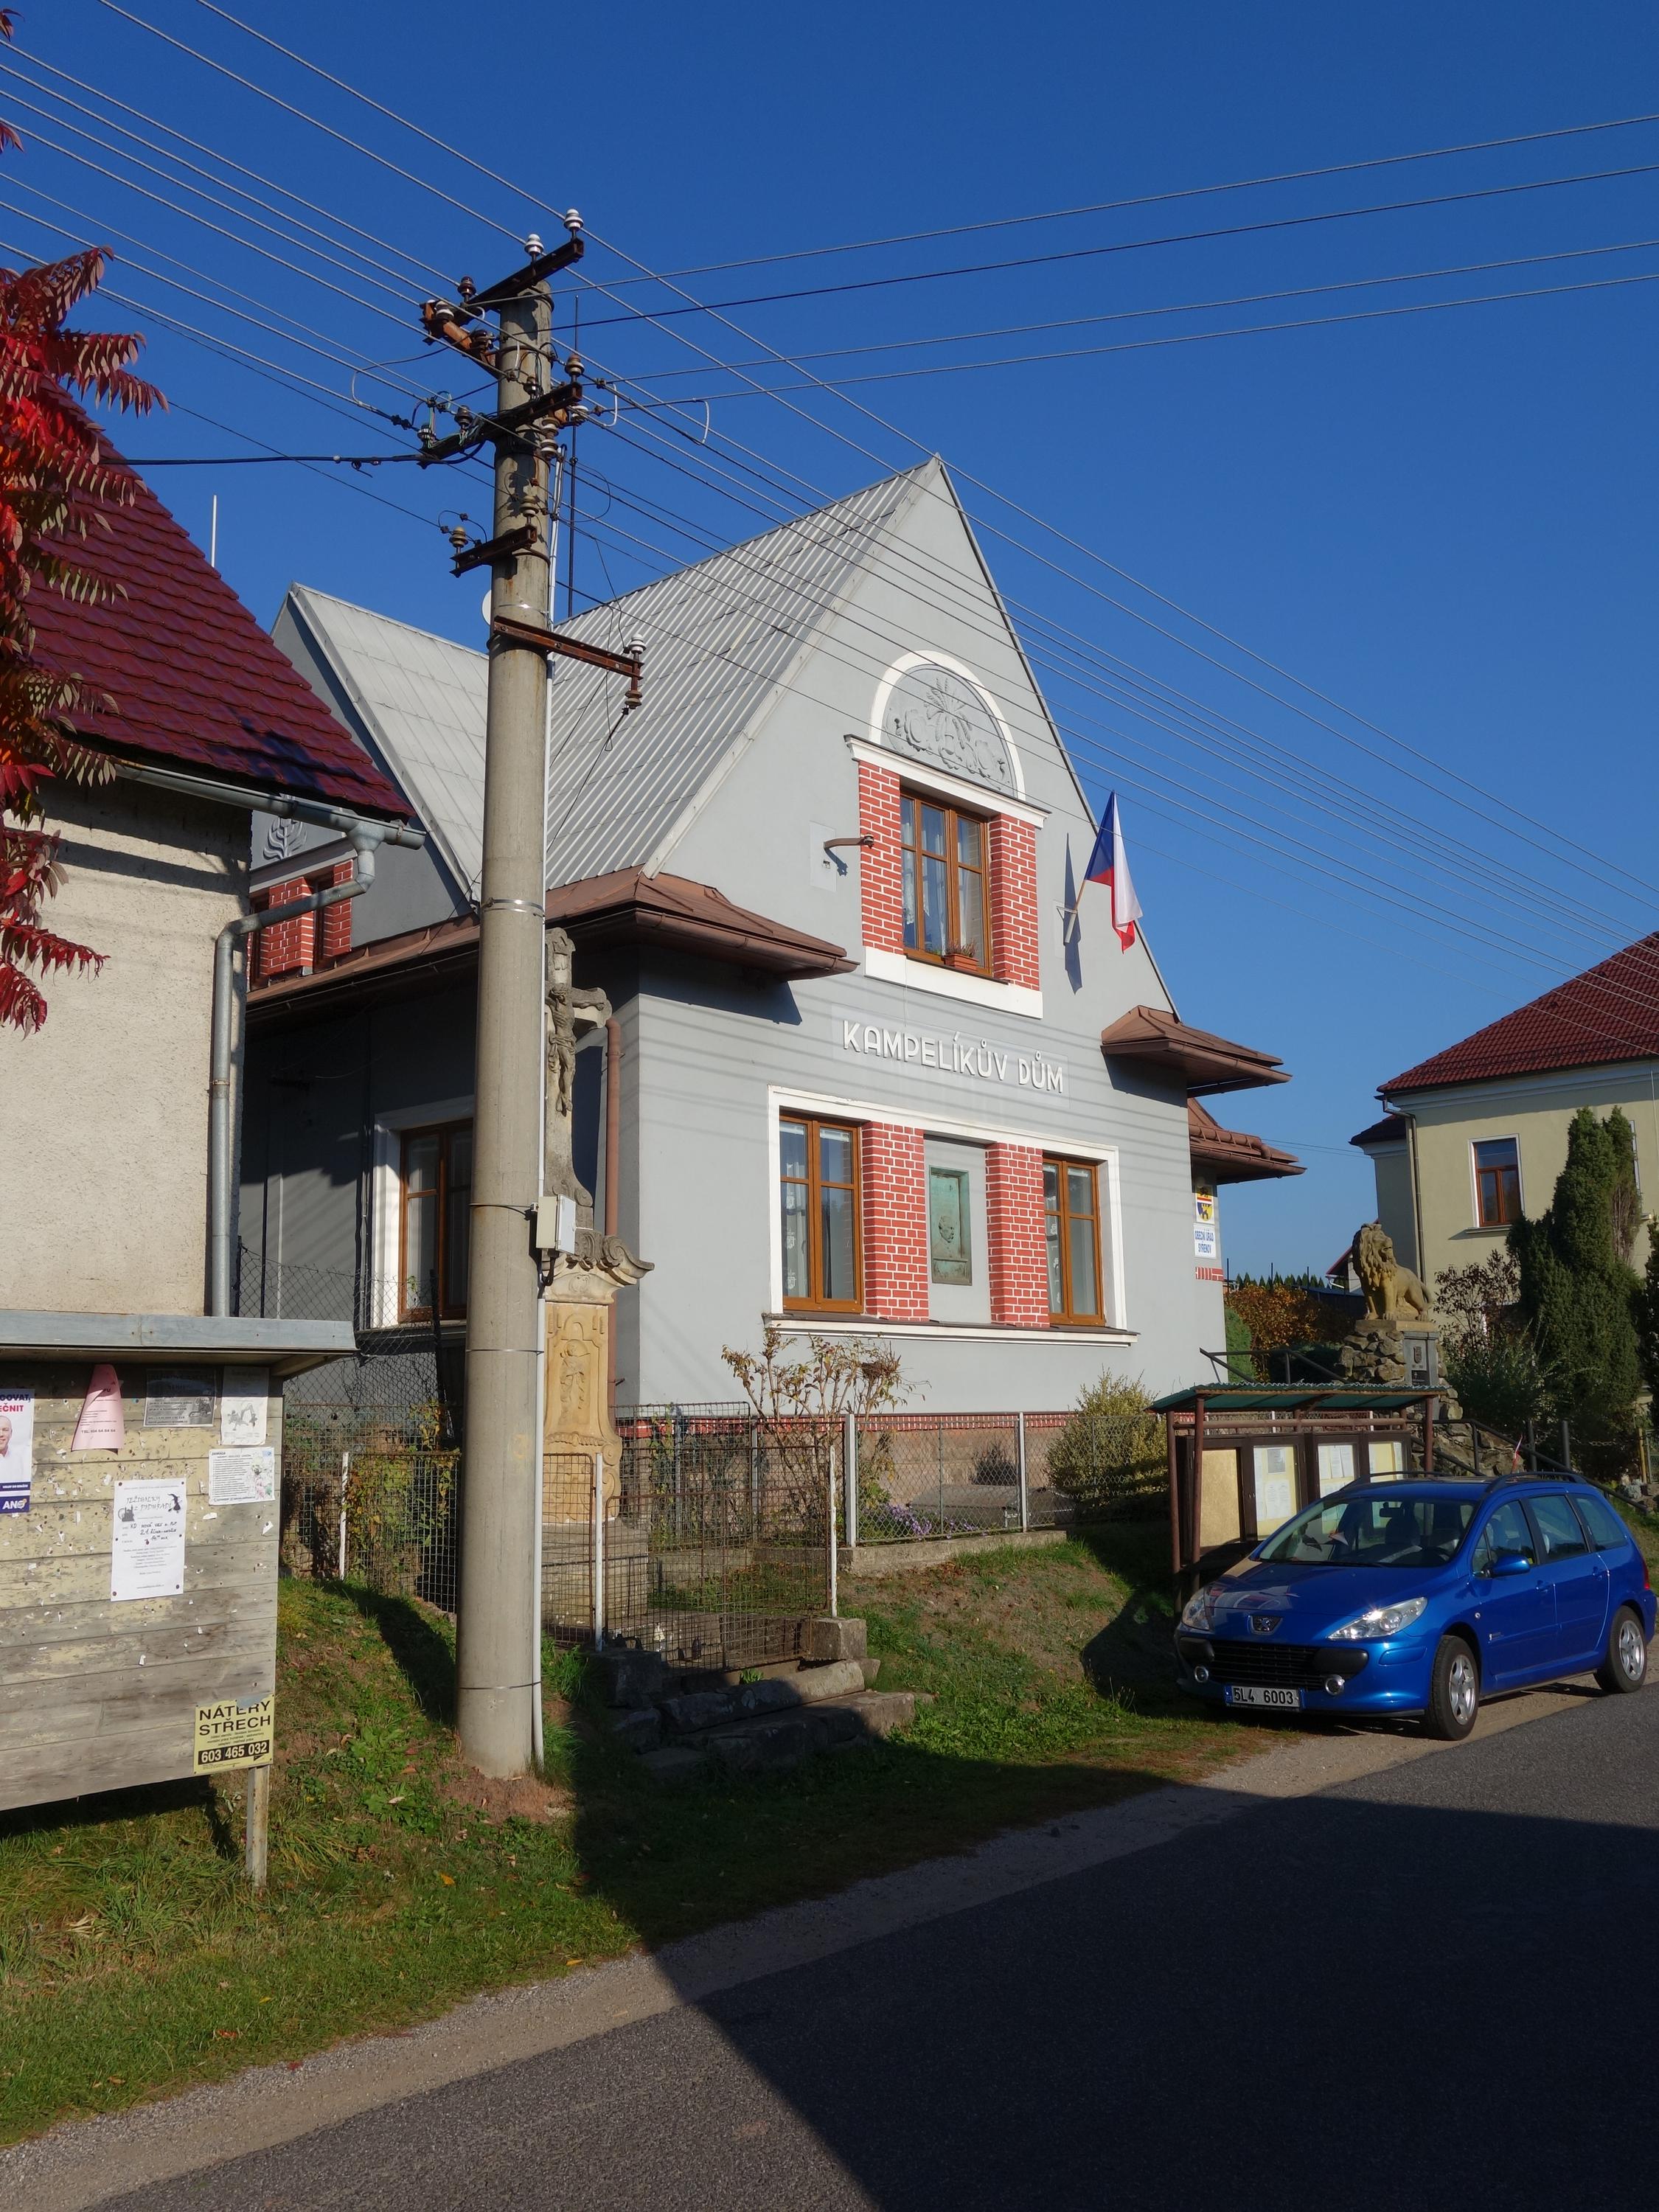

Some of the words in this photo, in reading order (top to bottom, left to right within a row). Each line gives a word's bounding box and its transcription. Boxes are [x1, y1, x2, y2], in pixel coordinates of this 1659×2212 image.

[843, 1020, 1008, 1082] KAMPELÍKŮV
[1018, 1050, 1063, 1094] DŮM
[2, 1499, 27, 1510] ANO
[1234, 1687, 1255, 1703] 5L4
[1263, 1689, 1293, 1705] 6003
[199, 1715, 271, 1736] STŘECH
[201, 1749, 221, 1763] 603
[225, 1745, 245, 1759] 465
[248, 1742, 267, 1755] 032
